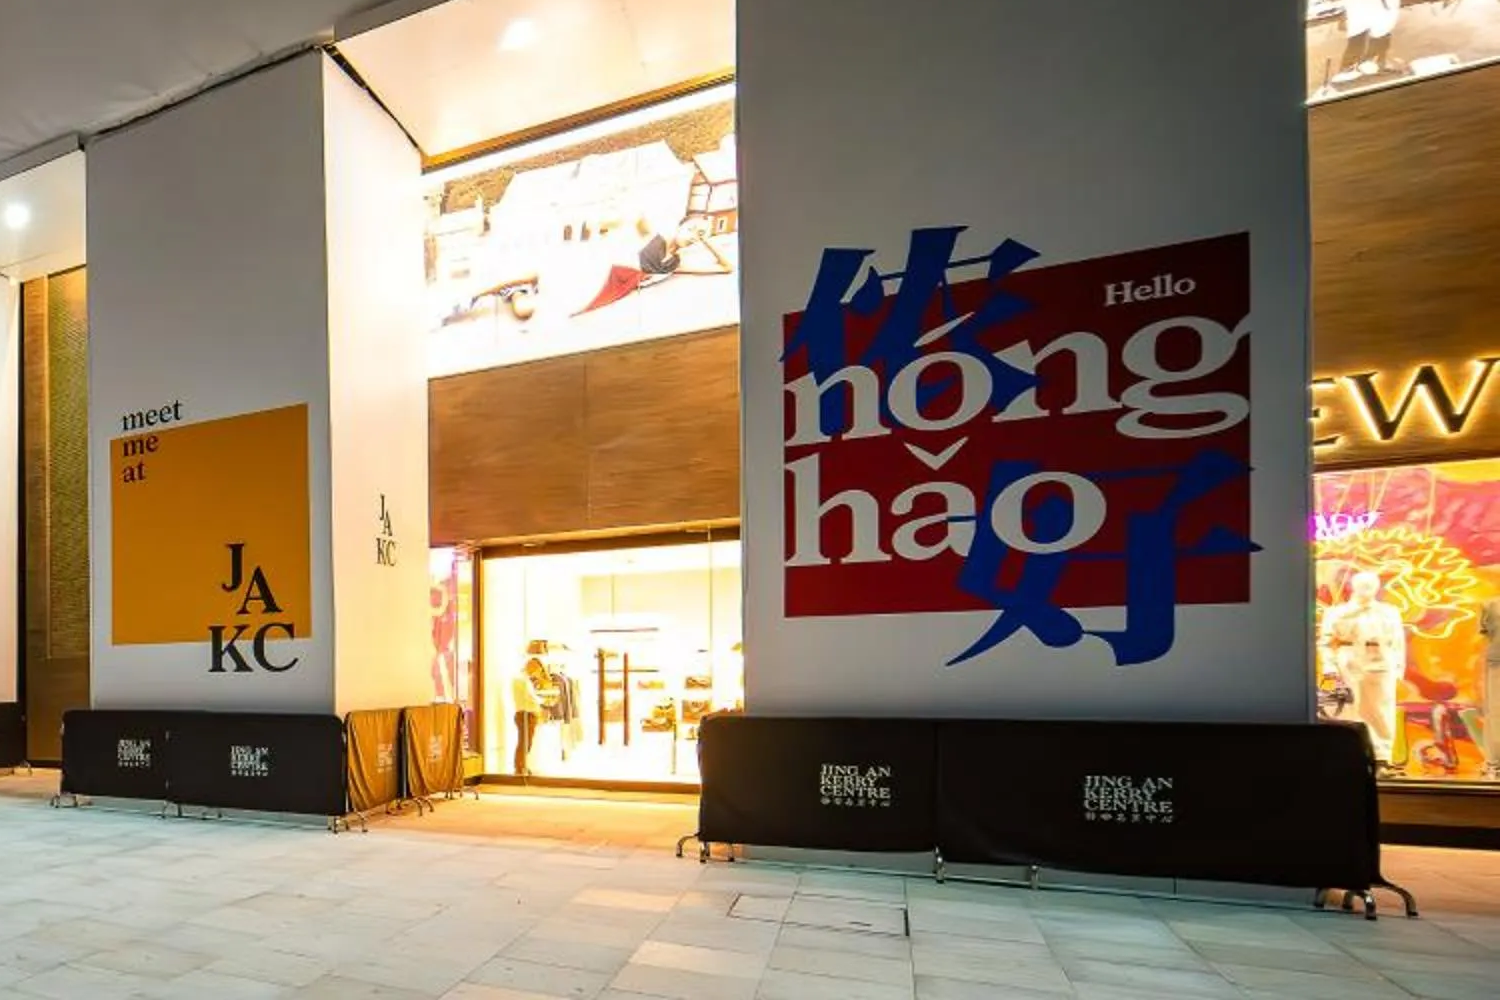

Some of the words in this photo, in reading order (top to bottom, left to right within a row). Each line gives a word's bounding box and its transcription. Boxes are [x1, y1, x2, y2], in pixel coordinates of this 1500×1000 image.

[1104, 273, 1197, 307] Hello
[122, 399, 184, 431] meet
[123, 435, 159, 457] me
[123, 461, 146, 483] at
[820, 764, 859, 777] JING
[866, 766, 891, 777] AN
[820, 775, 877, 787] KERRY
[1084, 775, 1132, 788] JING
[1142, 777, 1173, 791] AN
[820, 785, 891, 799] CENTRE
[1084, 786, 1156, 803] KERRY
[1083, 799, 1173, 813] CENTRE
